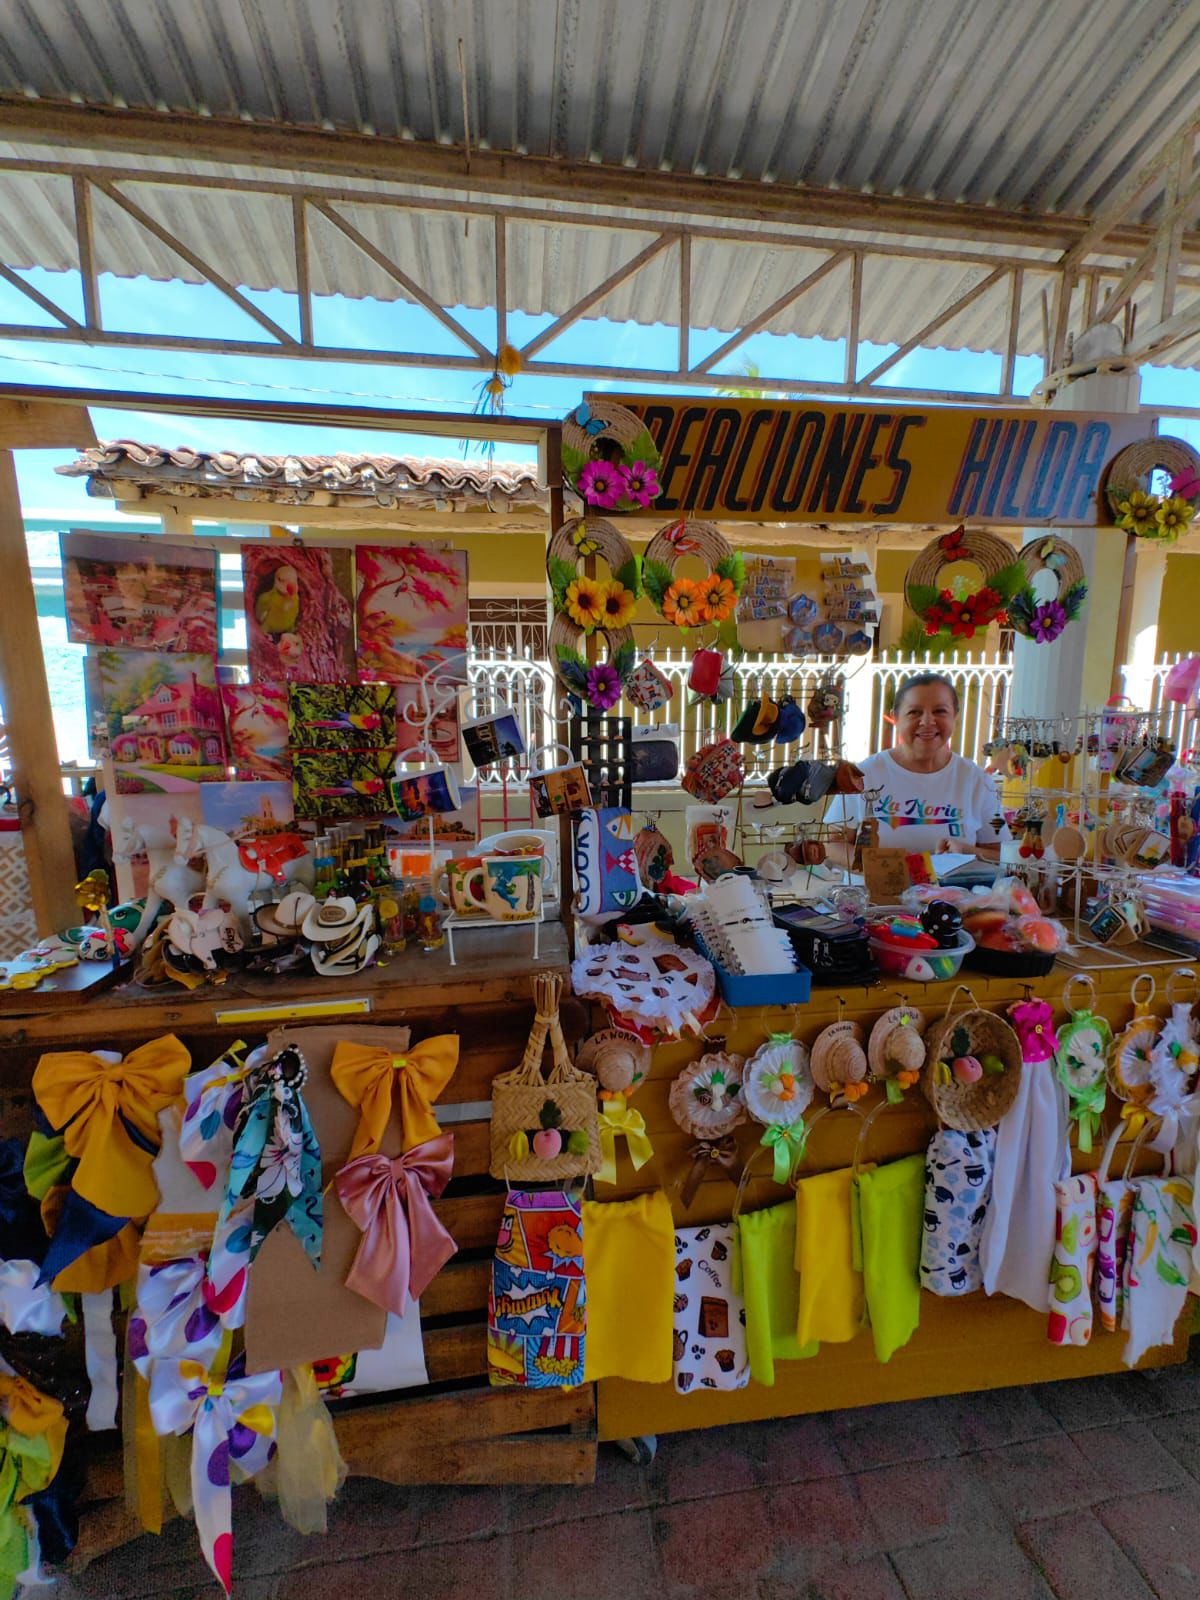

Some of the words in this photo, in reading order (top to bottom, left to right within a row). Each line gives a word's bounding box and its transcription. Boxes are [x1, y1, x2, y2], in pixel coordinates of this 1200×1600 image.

[624, 403, 927, 514] REACIONES
[947, 417, 1111, 519] HILDA
[875, 794, 900, 815] La
[904, 799, 964, 818] Noria
[697, 1259, 723, 1289] Coffee
[495, 1287, 562, 1318] Yummy!
